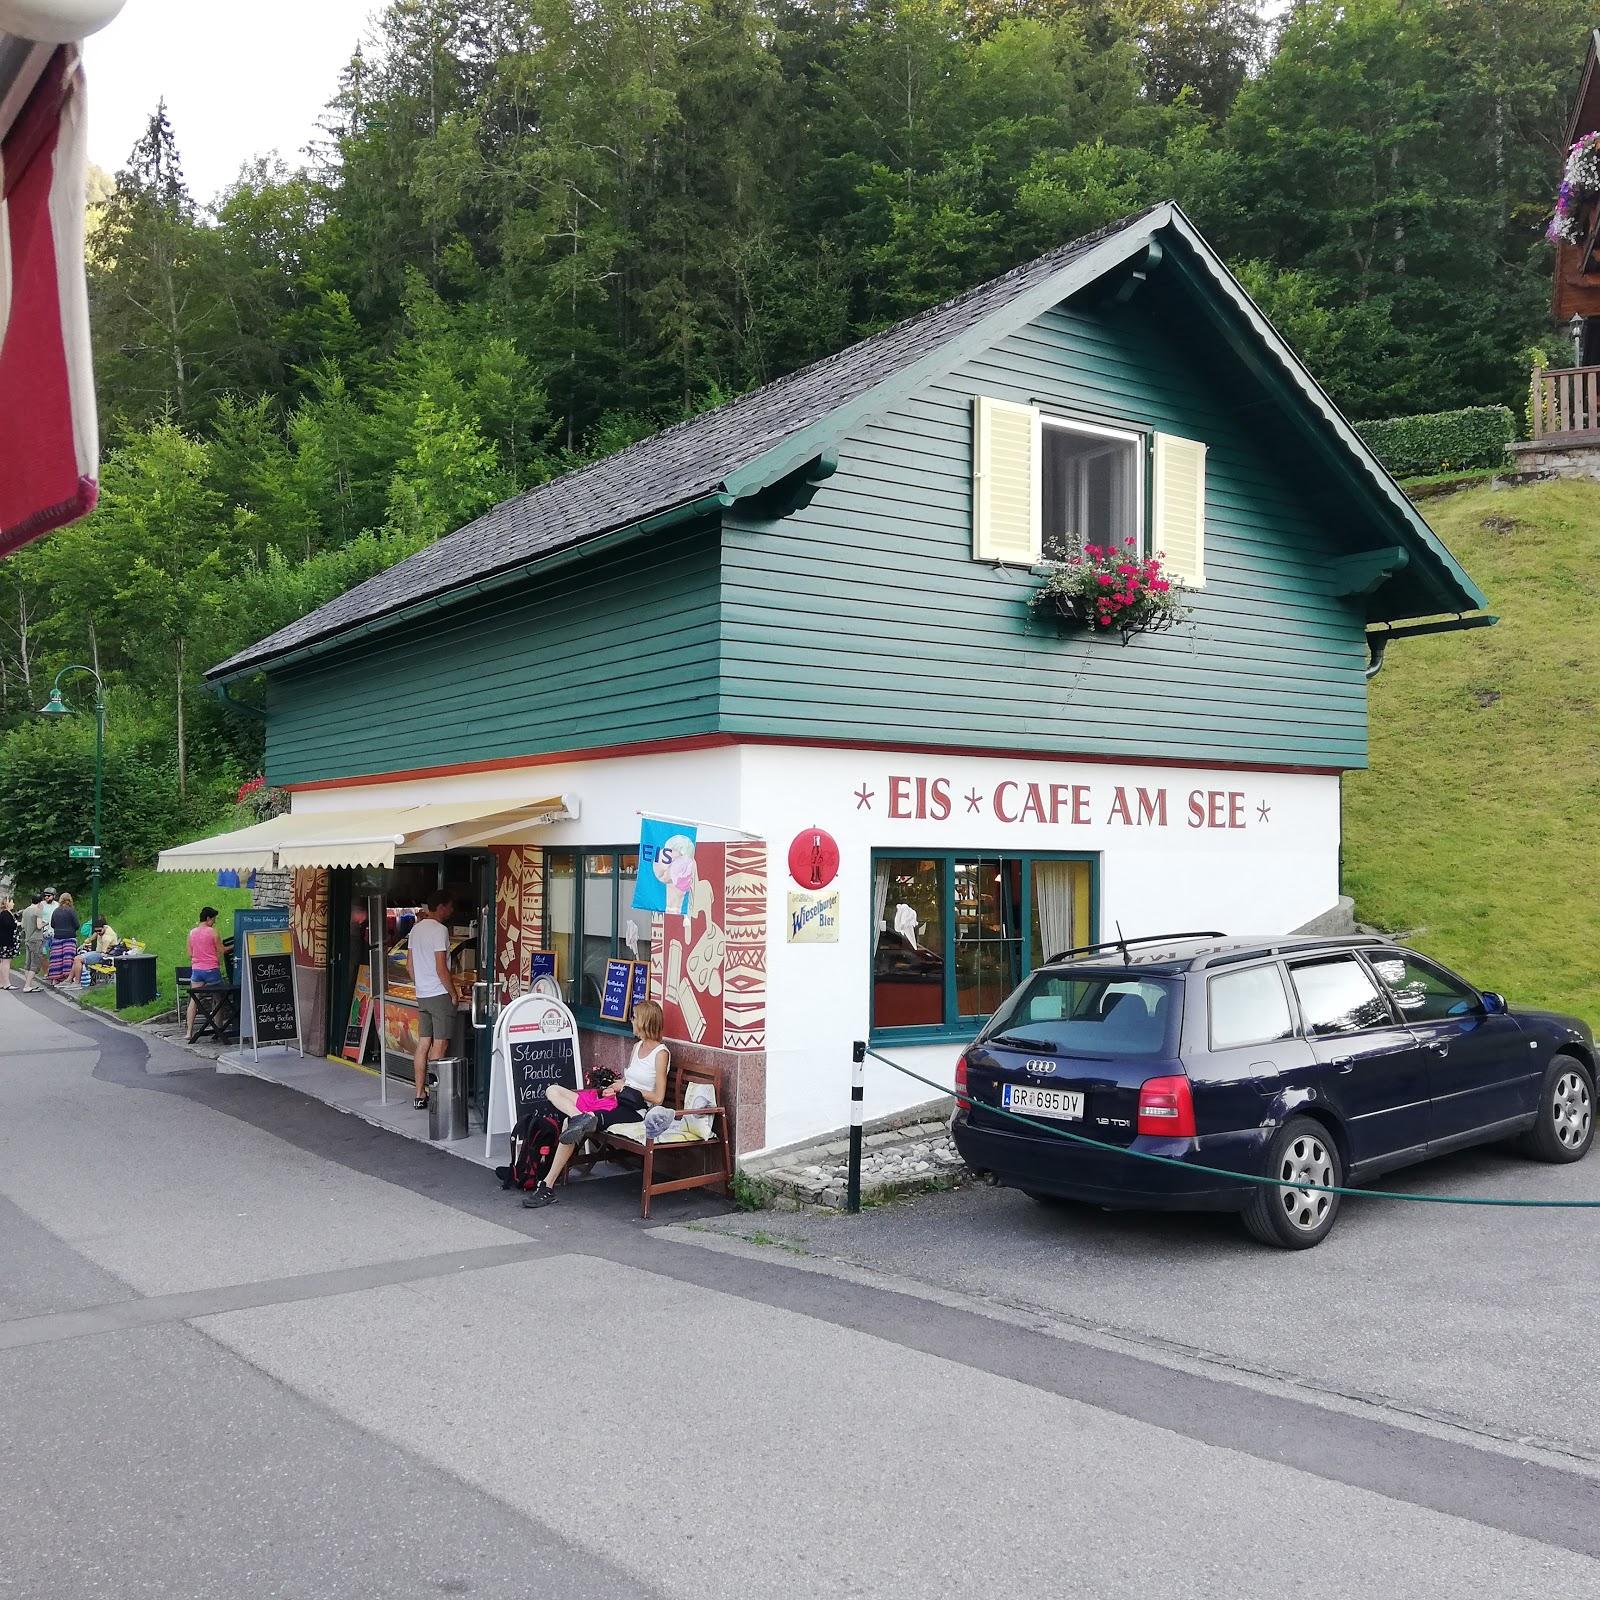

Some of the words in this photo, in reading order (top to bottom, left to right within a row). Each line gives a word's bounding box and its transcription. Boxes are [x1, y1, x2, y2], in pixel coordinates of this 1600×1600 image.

[887, 775, 952, 821] EIS
[993, 780, 1092, 825] CAFE
[1106, 786, 1168, 827] AM
[1187, 789, 1247, 829] SEE
[642, 844, 673, 865] EIS
[792, 896, 838, 939] Wieselburger
[819, 913, 835, 927] Bier
[261, 982, 286, 994] Vanille
[513, 1042, 556, 1061] Stand
[559, 1041, 573, 1063] Up
[523, 1064, 562, 1080] Paddle
[1013, 1088, 1028, 1106] GR
[1036, 1092, 1060, 1110] 695
[1062, 1095, 1079, 1113] DV
